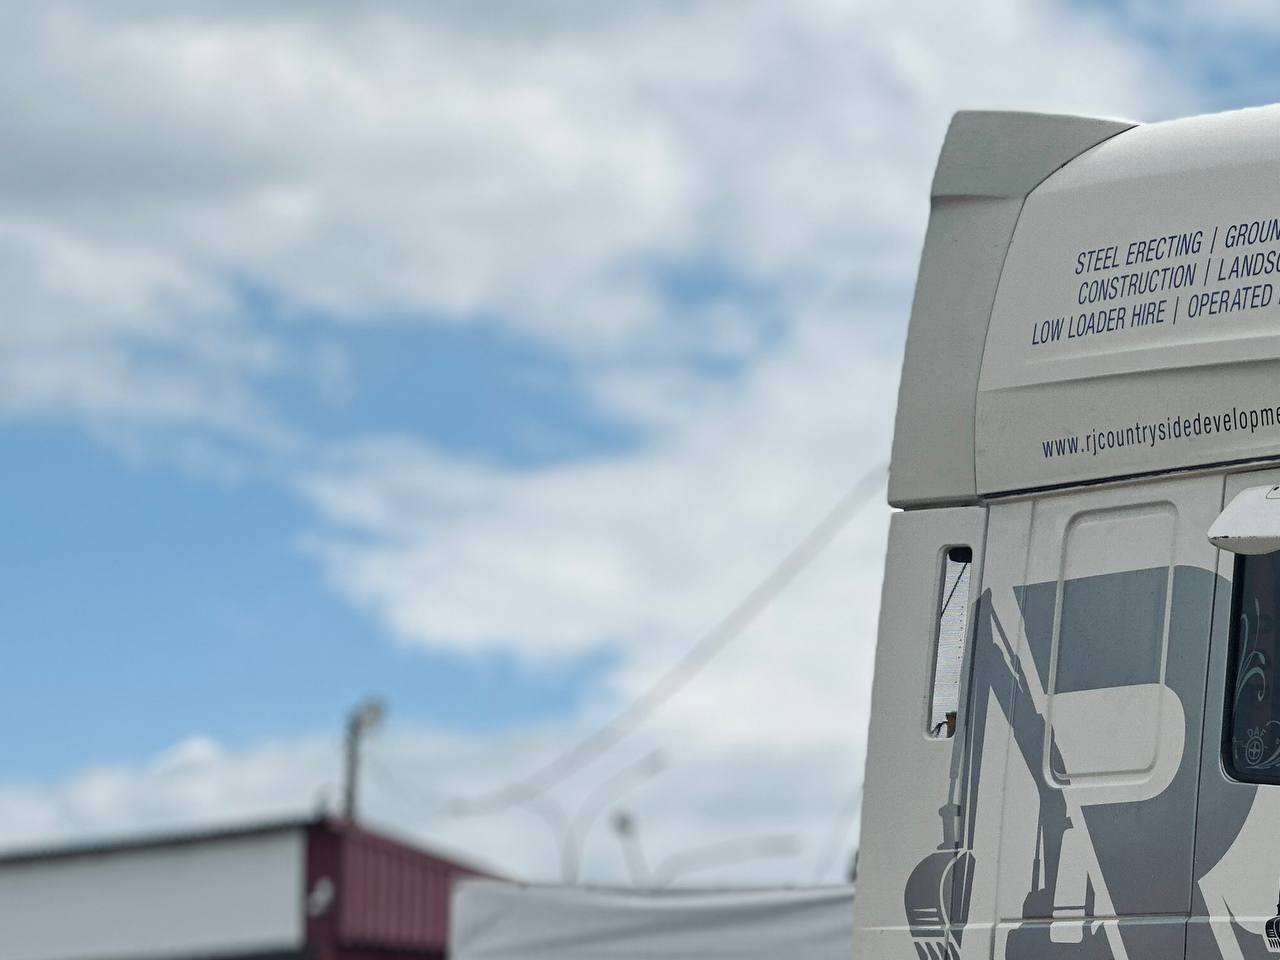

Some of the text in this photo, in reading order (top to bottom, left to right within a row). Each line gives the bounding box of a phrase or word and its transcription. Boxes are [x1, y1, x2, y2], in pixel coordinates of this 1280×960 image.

[1075, 246, 1120, 275] STEEL
[1126, 231, 1203, 265] ERECTING
[1079, 263, 1197, 304] CONSTRUCTION
[1032, 317, 1064, 345] LOW
[1068, 307, 1126, 338] LOADER
[1131, 300, 1167, 327] HIRE
[1188, 283, 1273, 318] OPERATED
